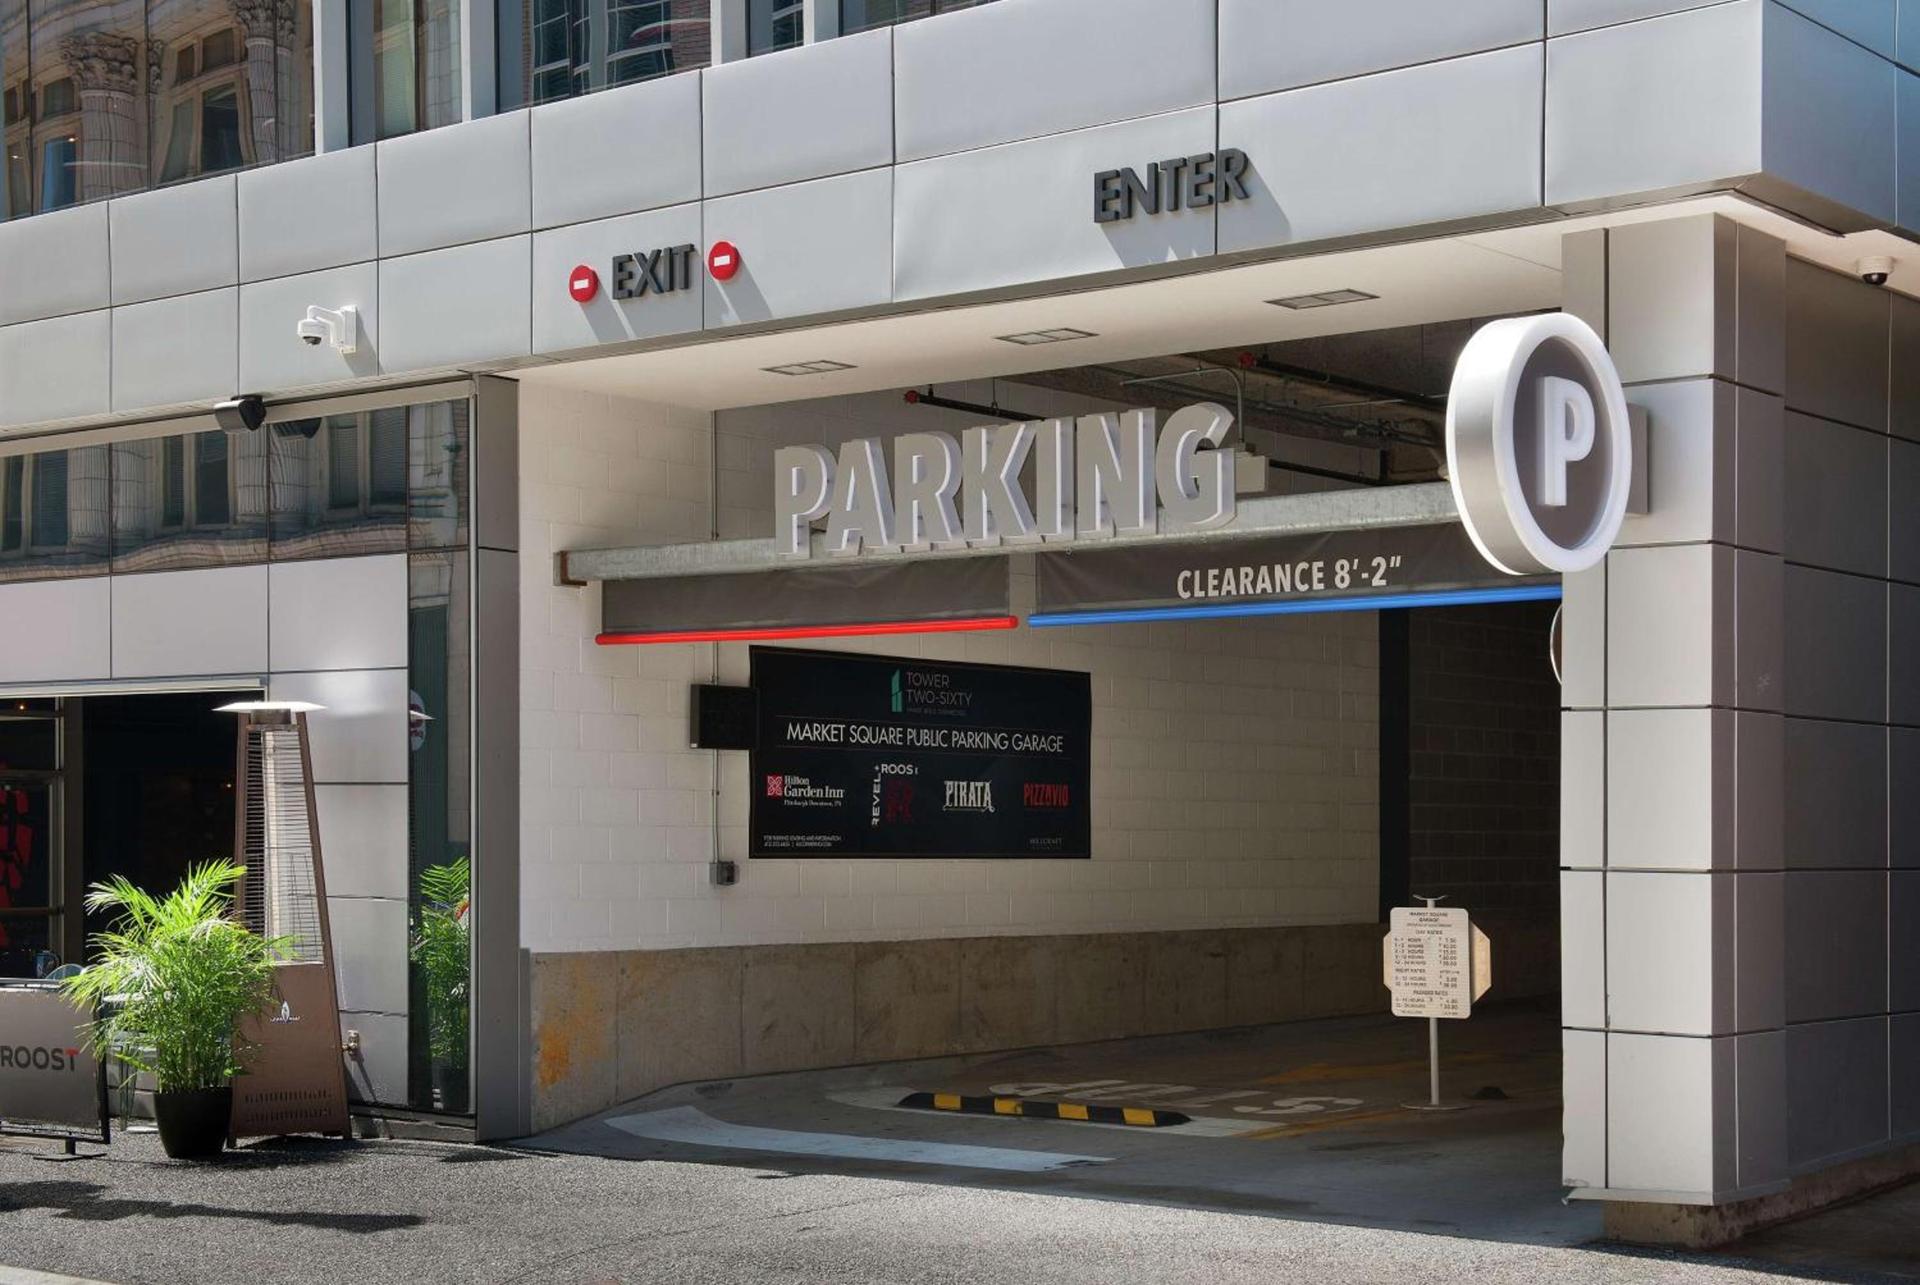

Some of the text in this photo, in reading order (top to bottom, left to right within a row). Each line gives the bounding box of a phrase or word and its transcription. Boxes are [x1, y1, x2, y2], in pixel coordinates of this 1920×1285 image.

[1094, 148, 1250, 223] ENTER
[612, 243, 695, 300] EXIT
[1536, 375, 1596, 507] P
[774, 402, 1237, 560] PARKING
[1176, 560, 1326, 600] CLEARANCE
[906, 671, 950, 689] TOWER
[906, 688, 973, 706] TWO-SIXTY
[786, 721, 1064, 752] MARKET SQUARE PUBLIC PARKING GARAGE
[783, 785, 845, 799] Garden Inn
[784, 775, 810, 786] Hilton
[943, 780, 995, 812] PIRATA
[871, 772, 882, 826] REVEL
[0, 1045, 80, 1072] ROOST
